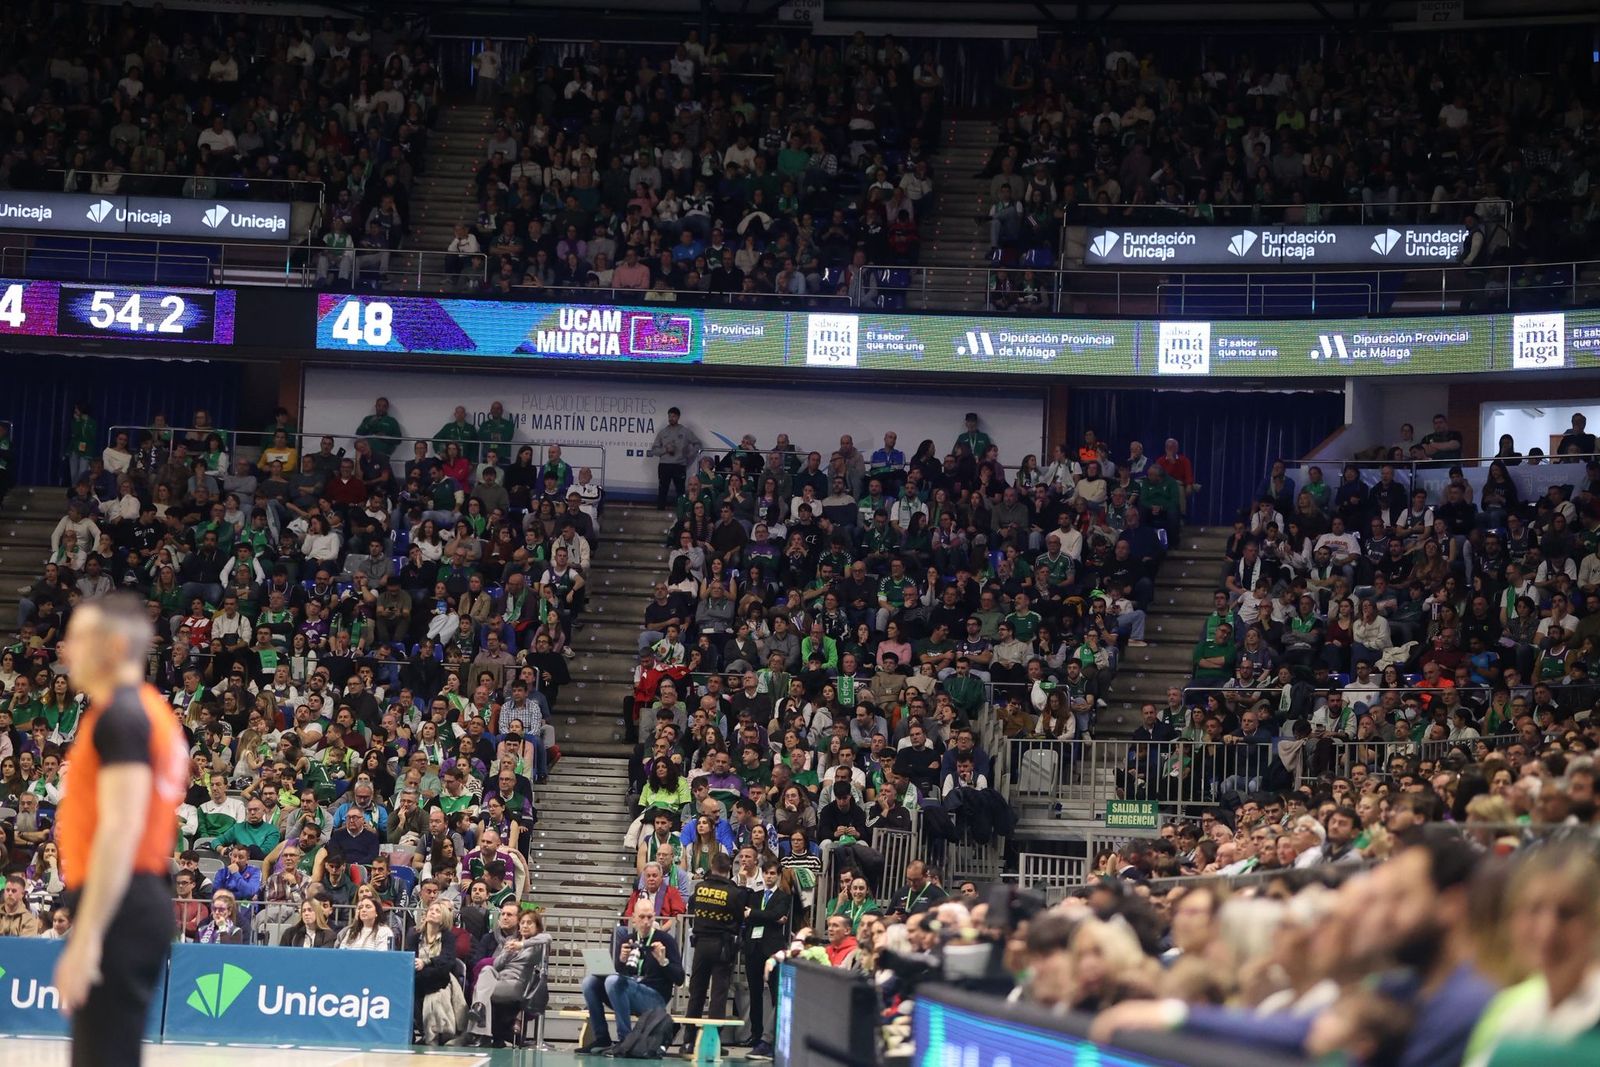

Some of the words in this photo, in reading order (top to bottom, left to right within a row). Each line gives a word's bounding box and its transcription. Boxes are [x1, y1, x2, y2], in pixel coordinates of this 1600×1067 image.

[793, 9, 810, 20] C6
[115, 208, 172, 227] Unicaja
[231, 213, 286, 232] Unicaja
[1123, 232, 1196, 245] Fundación
[1261, 230, 1336, 244] Fundación
[1405, 229, 1469, 243] Fundaci
[1122, 245, 1175, 261] Unicaja
[1261, 244, 1315, 260] Unicaja
[89, 290, 185, 334] 54.2
[332, 301, 393, 346] 48
[559, 307, 622, 332] UCAM
[711, 324, 764, 336] Provincial
[866, 331, 876, 340] El
[877, 332, 905, 341] sabor
[1573, 329, 1582, 337] El
[1584, 328, 1600, 338] sab
[536, 330, 622, 355] MURCIA
[999, 332, 1058, 345] Diputación
[1061, 333, 1115, 345] Provincial
[1218, 338, 1228, 347] El
[1230, 338, 1257, 347] sabor
[1353, 332, 1412, 346] Diputación
[1415, 331, 1469, 343] Provincial
[1573, 340, 1591, 348] que
[813, 339, 851, 362] laga
[866, 342, 884, 351] que
[886, 342, 904, 350] nos
[905, 343, 925, 351] une
[999, 345, 1013, 356] de
[1015, 345, 1056, 358] Málaga
[1218, 349, 1237, 358] que
[1239, 349, 1257, 357] nos
[1258, 349, 1278, 357] une
[1353, 347, 1367, 358] de
[1369, 347, 1410, 360] Málaga
[1518, 341, 1559, 364] laga
[1164, 348, 1203, 370] laga
[521, 393, 574, 412] PALACIO
[575, 395, 591, 413] DE
[593, 396, 657, 415] DEPORTES
[531, 411, 585, 432] MARTÍN
[590, 415, 655, 434] CARPENA
[840, 677, 851, 696] icaja
[1112, 803, 1139, 813] SALIDA
[1142, 803, 1153, 814] DE
[1107, 814, 1155, 826] EMERGENCIA
[696, 886, 728, 900] COFER
[695, 896, 727, 907] SEGURIDAD
[257, 984, 391, 1027] Unicaja
